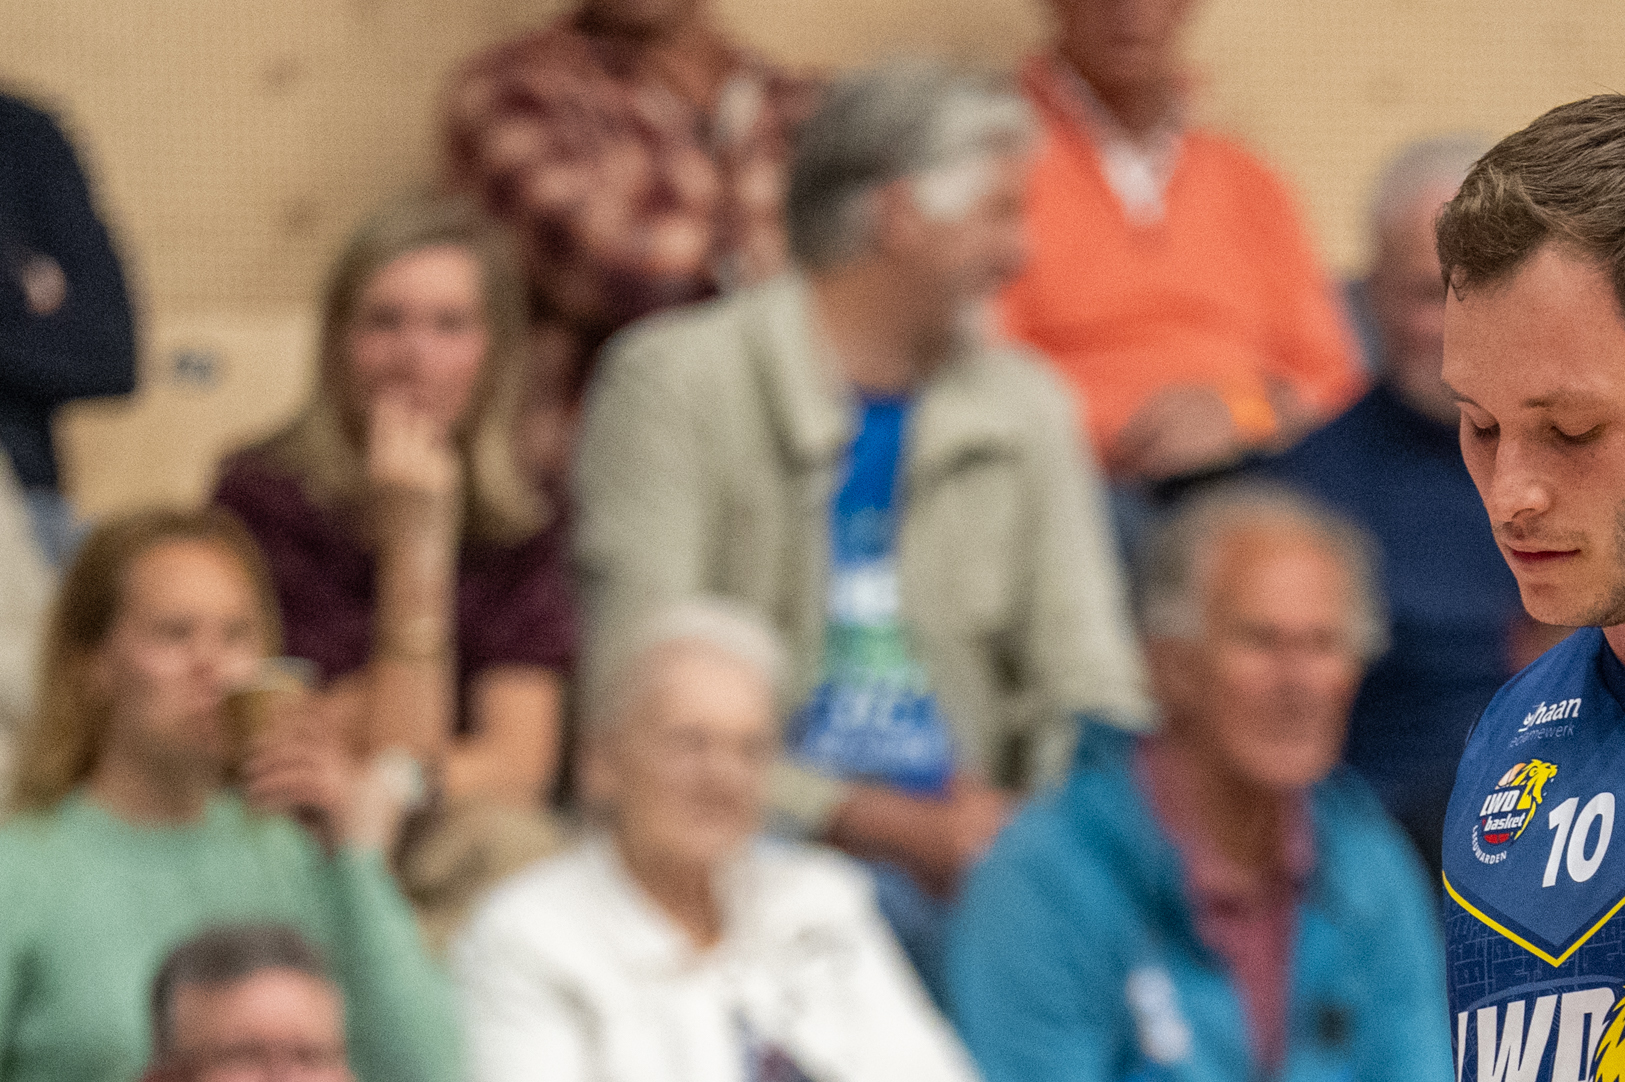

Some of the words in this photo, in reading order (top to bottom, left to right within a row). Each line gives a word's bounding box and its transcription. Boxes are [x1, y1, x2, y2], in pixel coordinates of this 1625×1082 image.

[1480, 789, 1520, 816] LWD
[1484, 812, 1527, 831] basket
[1542, 792, 1615, 887] 10
